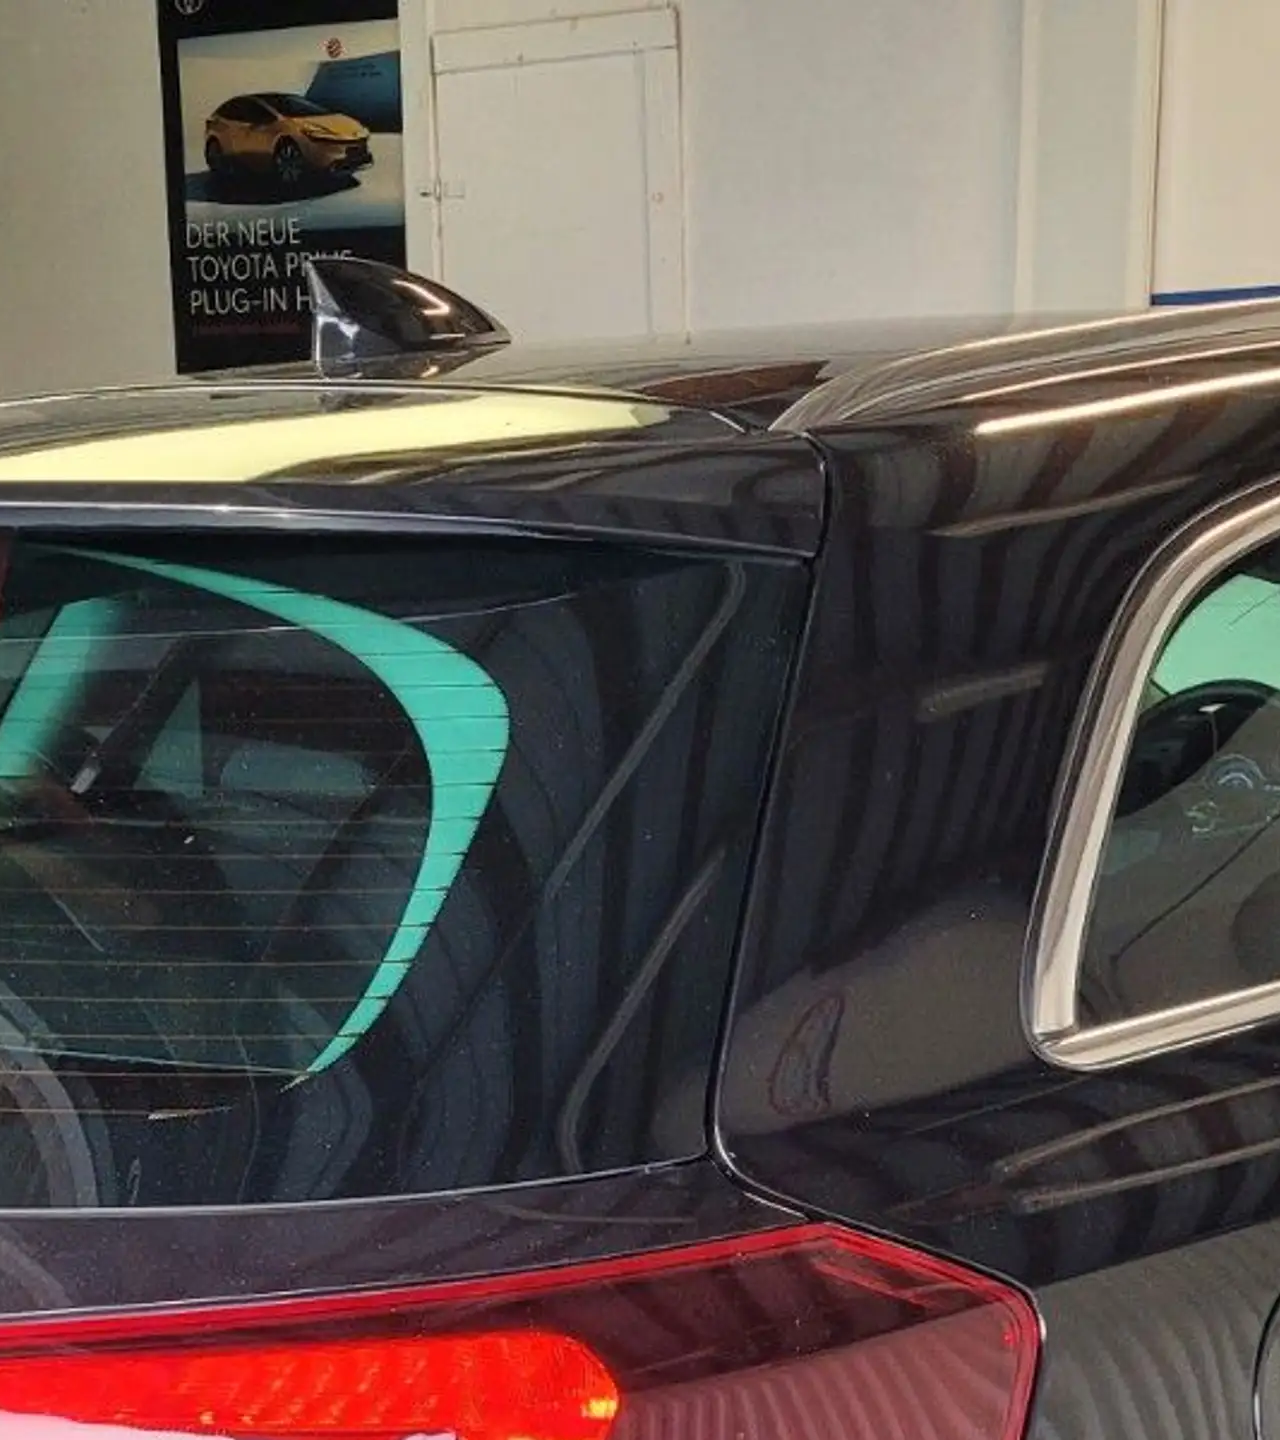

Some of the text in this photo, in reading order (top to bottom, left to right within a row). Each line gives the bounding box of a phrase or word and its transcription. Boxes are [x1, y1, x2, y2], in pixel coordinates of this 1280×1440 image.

[186, 218, 301, 249] DER NEUE
[186, 253, 279, 283] TOYOTA
[190, 285, 287, 316] PLUG-IN
